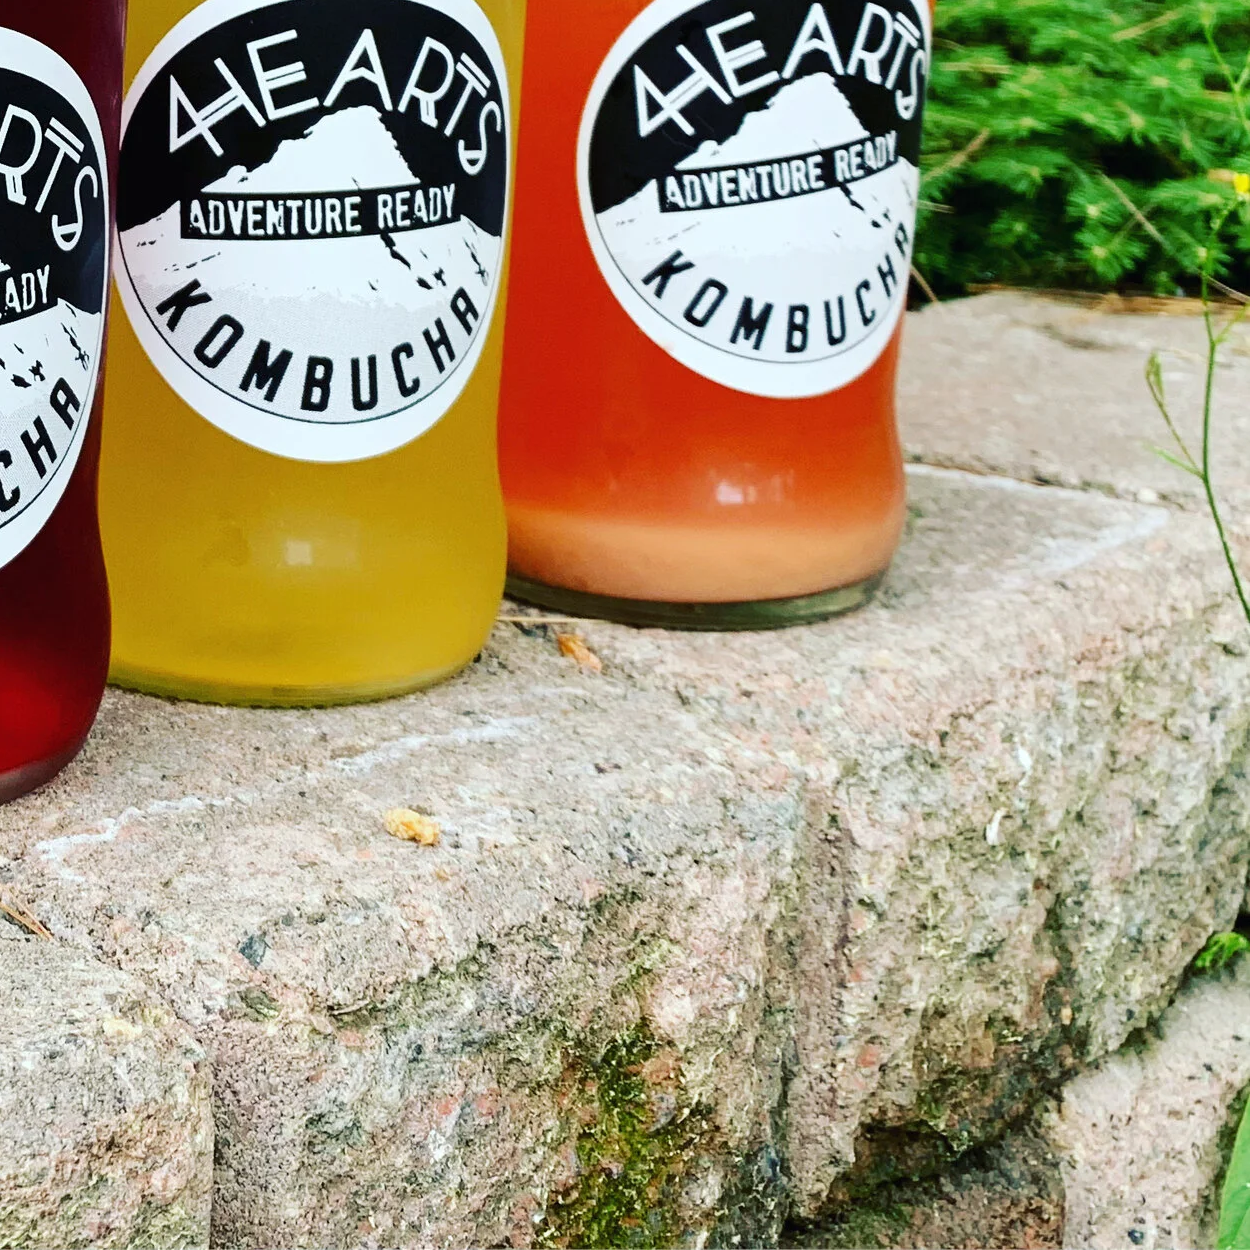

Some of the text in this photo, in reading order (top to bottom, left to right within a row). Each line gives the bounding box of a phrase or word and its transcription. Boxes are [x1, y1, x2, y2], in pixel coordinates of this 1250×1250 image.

[189, 183, 456, 236] ADVENTURE READY
[665, 131, 898, 210] ADVENTURE READY
[641, 223, 910, 354] KOMBUCHA
[156, 279, 479, 412] KOMBUCHA
